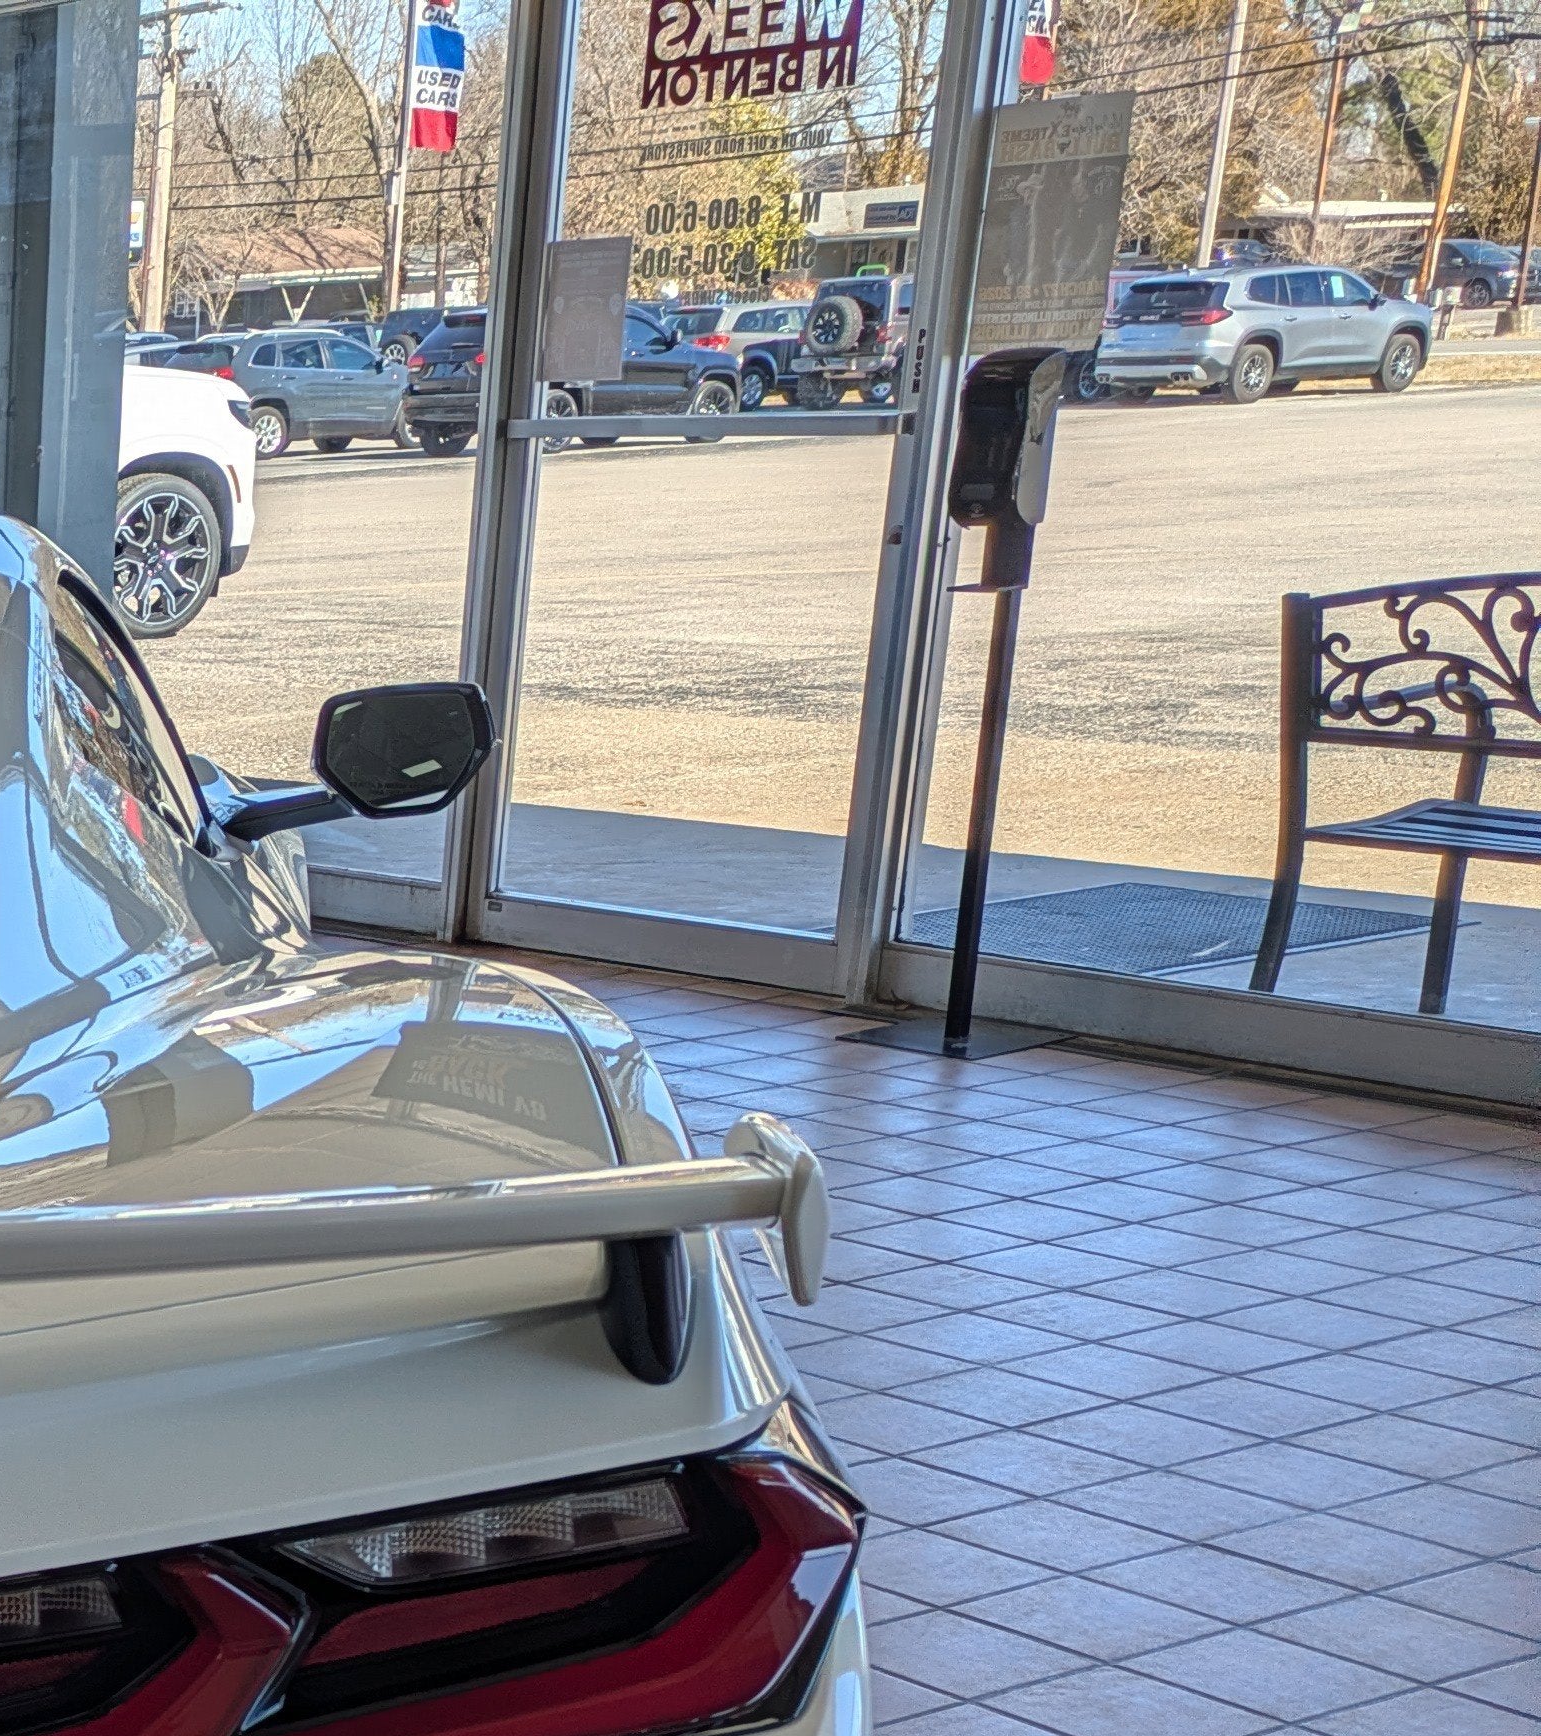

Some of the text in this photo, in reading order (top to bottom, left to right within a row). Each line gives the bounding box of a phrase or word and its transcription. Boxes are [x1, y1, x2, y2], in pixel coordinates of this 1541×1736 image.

[417, 69, 462, 90] USED
[416, 87, 458, 108] CARS
[911, 328, 927, 394] PUSH
